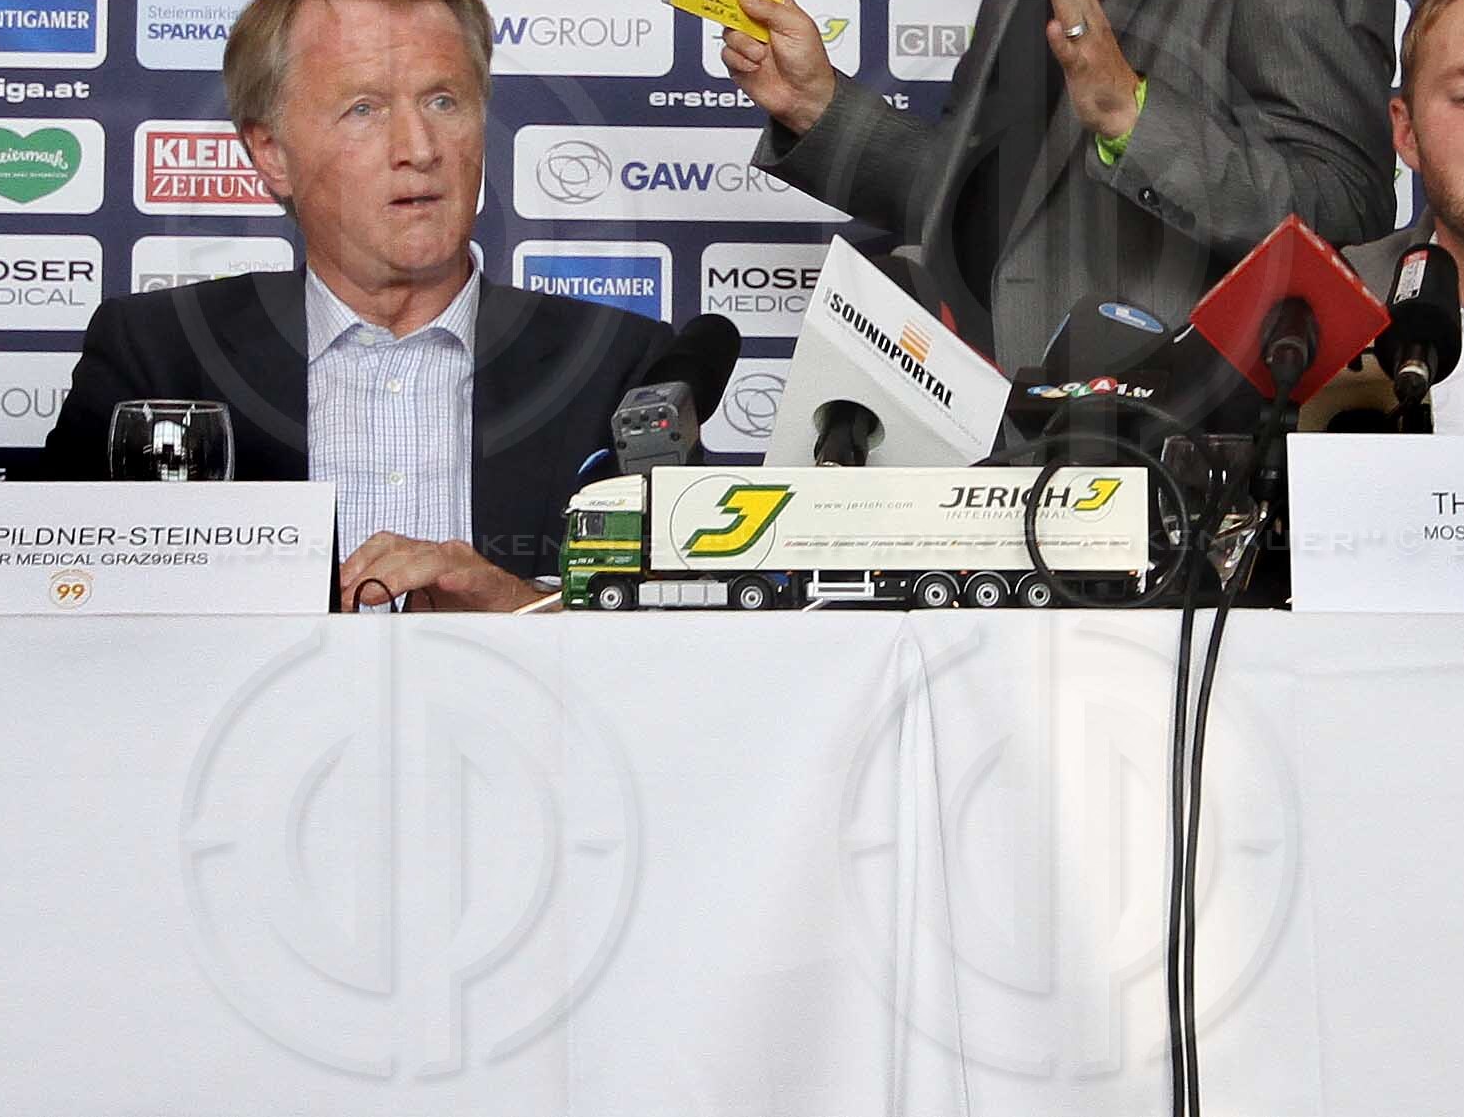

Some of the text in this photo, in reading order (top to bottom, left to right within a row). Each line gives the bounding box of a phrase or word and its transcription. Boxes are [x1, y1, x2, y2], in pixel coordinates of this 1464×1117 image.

[153, 139, 249, 168] KLEIN
[531, 274, 655, 297] PUNTIGAMER
[830, 293, 954, 409] SOUNDPORTAL
[15, 553, 96, 566] MEDICAL
[100, 553, 209, 566] GRAZ99ERS
[56, 583, 85, 599] 99
